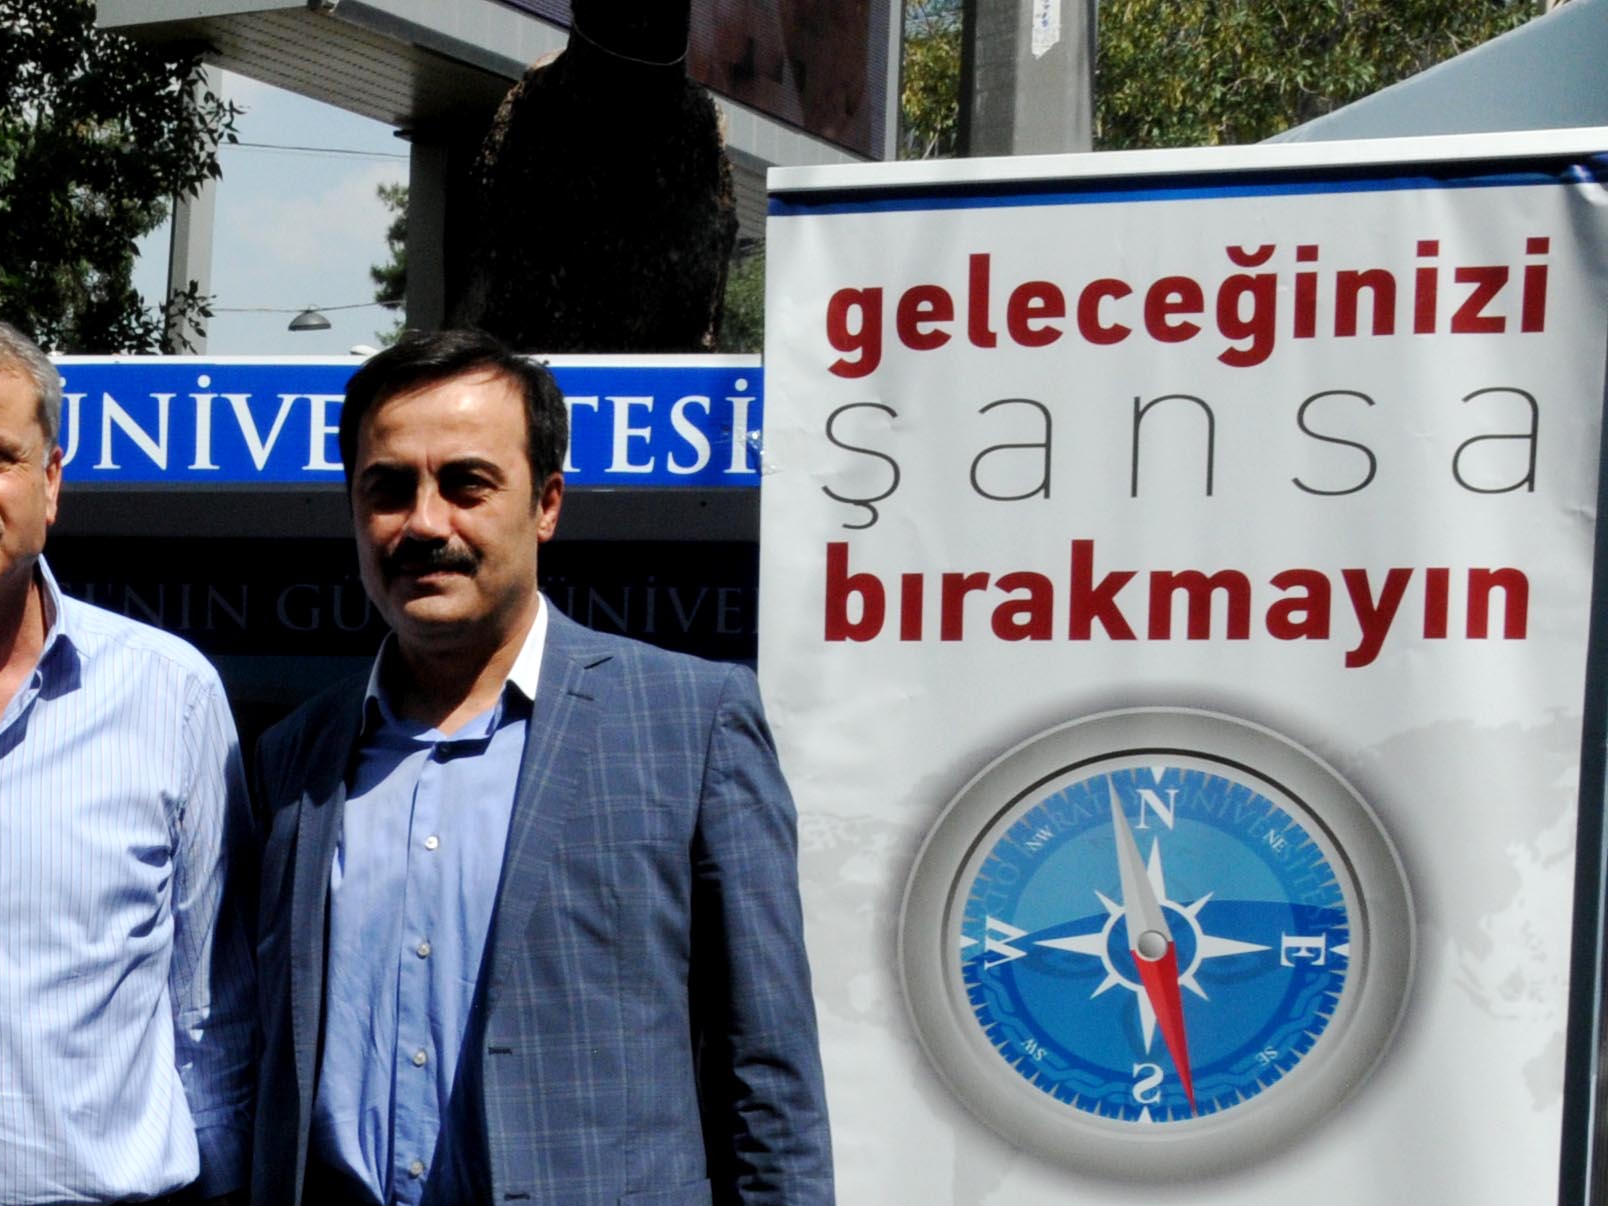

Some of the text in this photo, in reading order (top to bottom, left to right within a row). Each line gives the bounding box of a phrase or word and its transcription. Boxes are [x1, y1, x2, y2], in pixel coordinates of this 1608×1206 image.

[826, 236, 1551, 379] geleceğinizi
[821, 386, 1540, 530] şansa
[824, 538, 1531, 669] bırakmayın
[1136, 788, 1179, 831] N
